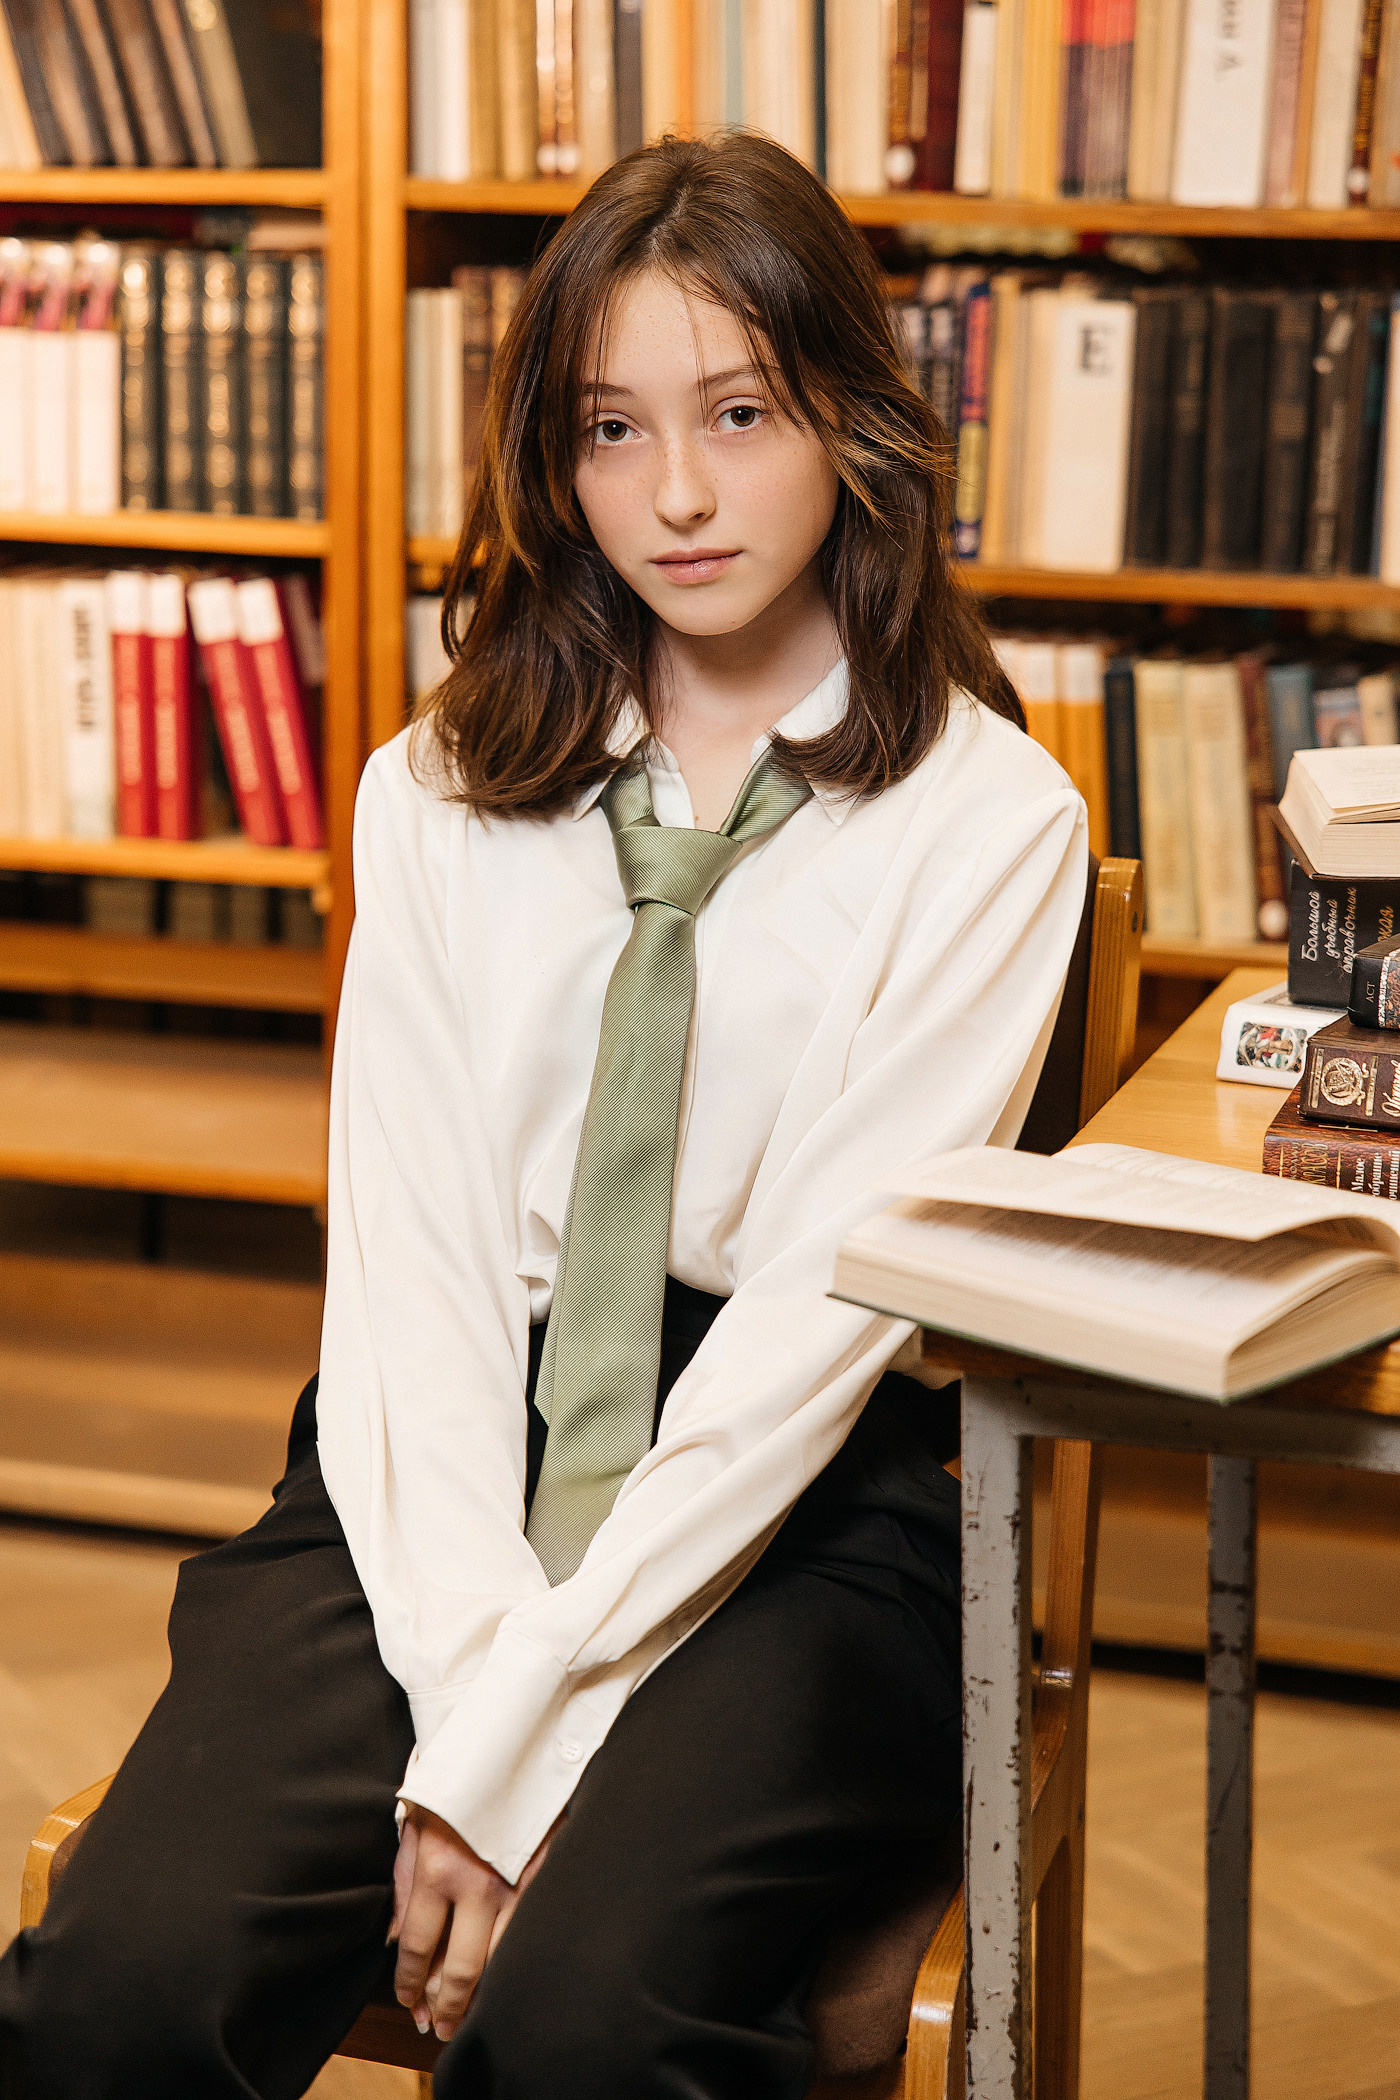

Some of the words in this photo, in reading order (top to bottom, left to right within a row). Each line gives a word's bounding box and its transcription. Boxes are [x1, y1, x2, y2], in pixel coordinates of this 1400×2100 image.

[1301, 890, 1320, 961] Большой
[1321, 898, 1341, 960] учебный
[1365, 981, 1375, 1003] АСТ
[1300, 1143, 1328, 1185] КРАСОВ
[1350, 1158, 1365, 1192] Малое
[1367, 1152, 1385, 1197] обрание
[1388, 1150, 1400, 1200] очинений
